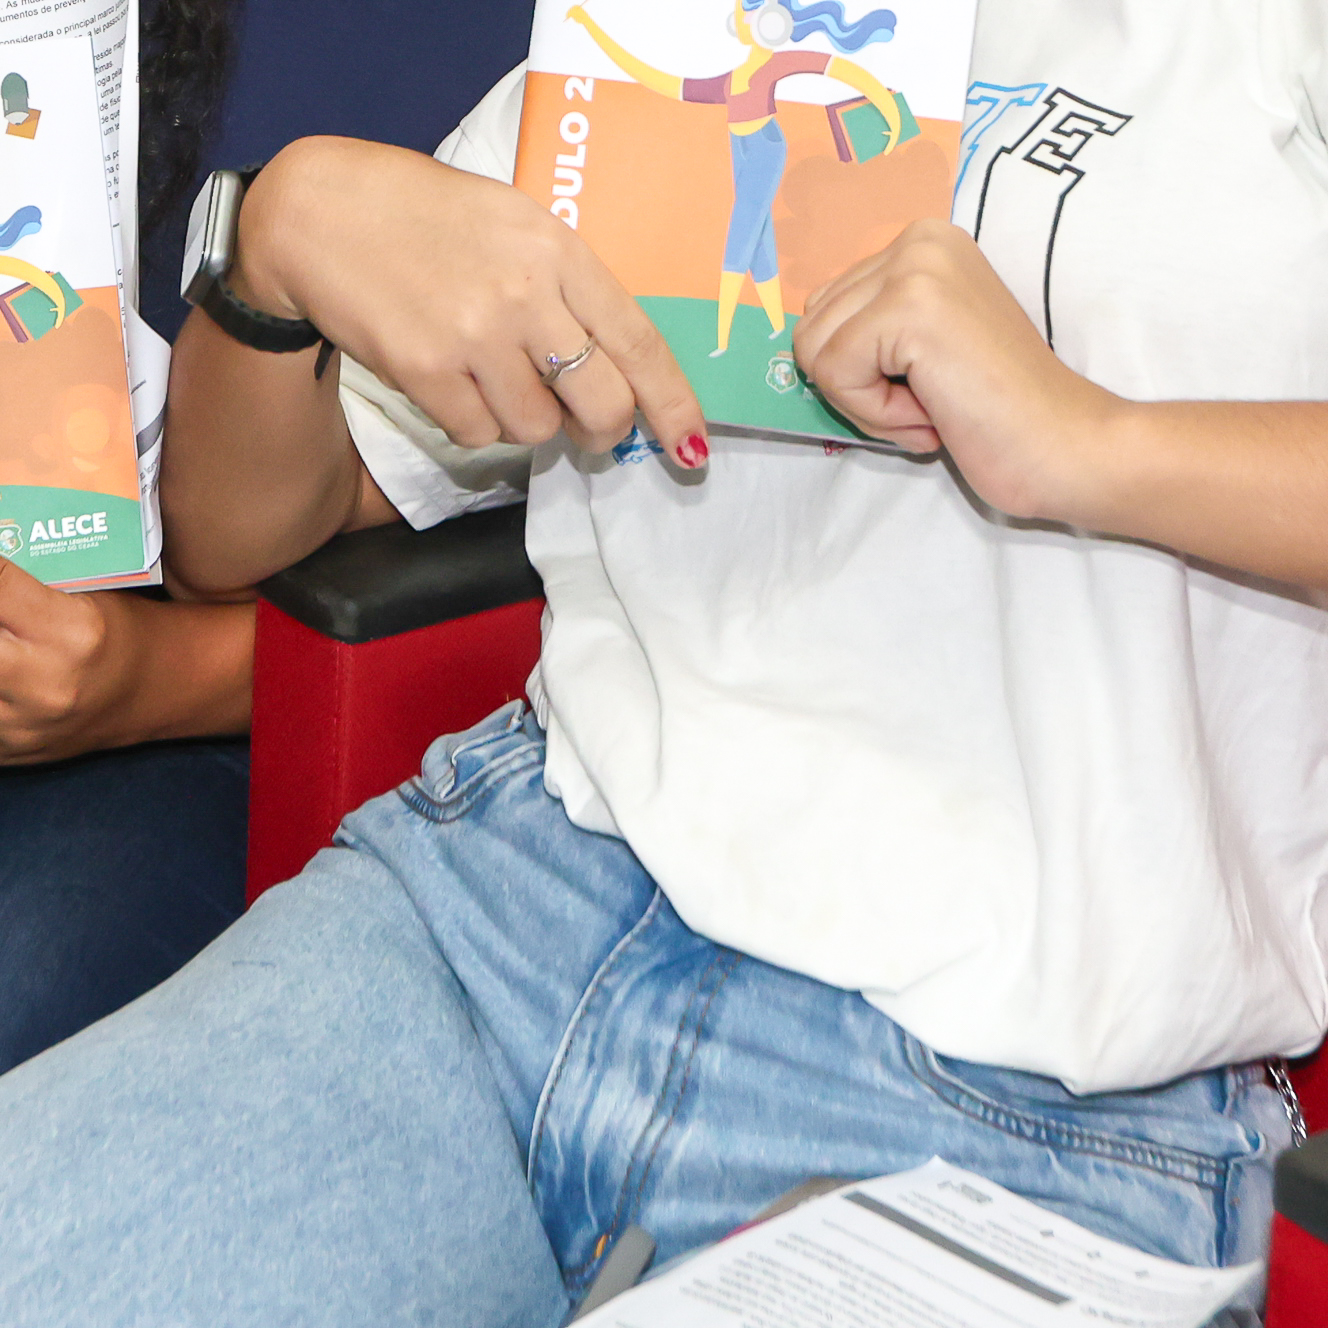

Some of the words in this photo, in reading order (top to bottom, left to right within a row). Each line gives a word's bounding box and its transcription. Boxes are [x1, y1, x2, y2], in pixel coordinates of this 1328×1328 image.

[6, 0, 18, 9] As
[40, 4, 52, 14] de
[564, 76, 594, 103] 2
[550, 111, 590, 230] DULO
[29, 511, 108, 543] ALECE
